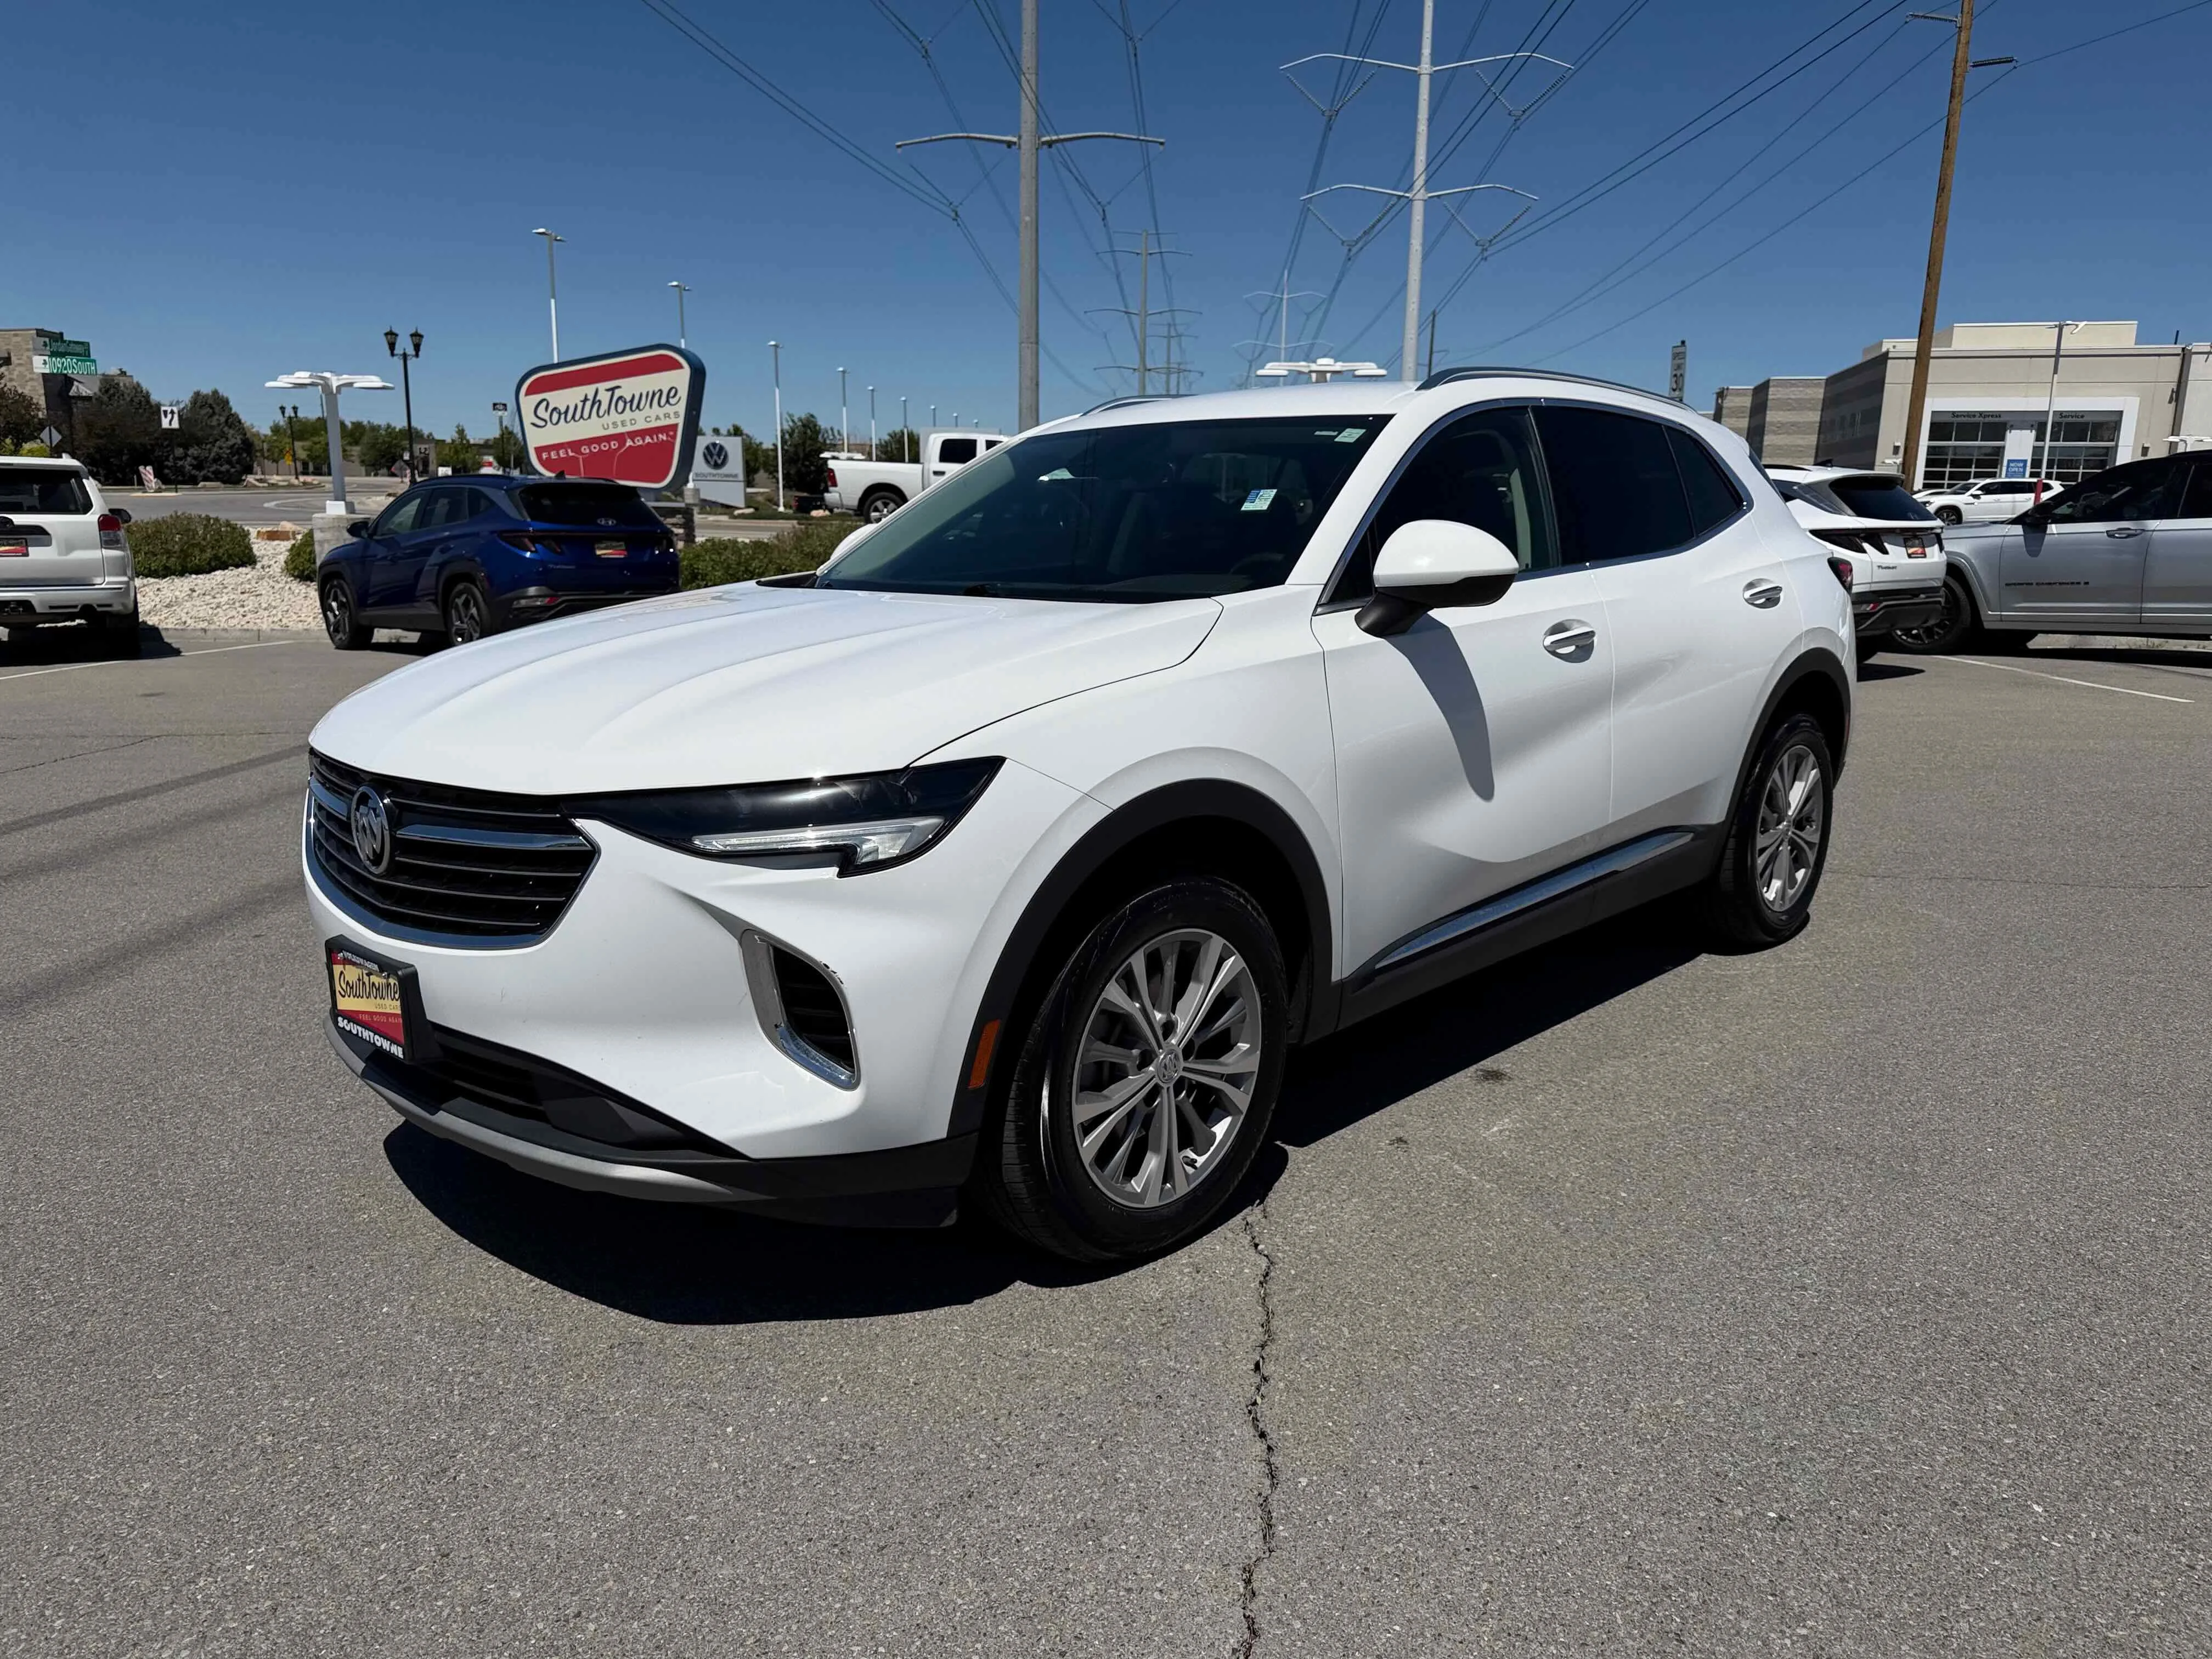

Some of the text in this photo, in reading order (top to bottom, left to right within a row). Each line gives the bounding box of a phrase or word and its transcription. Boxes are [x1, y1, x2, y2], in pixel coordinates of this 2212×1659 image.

[1672, 373, 1684, 391] 30
[531, 386, 681, 428] SouthTowne
[602, 411, 681, 431] USED CARS
[542, 448, 575, 460] FEEL
[581, 441, 618, 454] GOOD
[338, 969, 401, 1001] SouthTowne
[337, 1016, 404, 1059] SOUTHTOWNE
